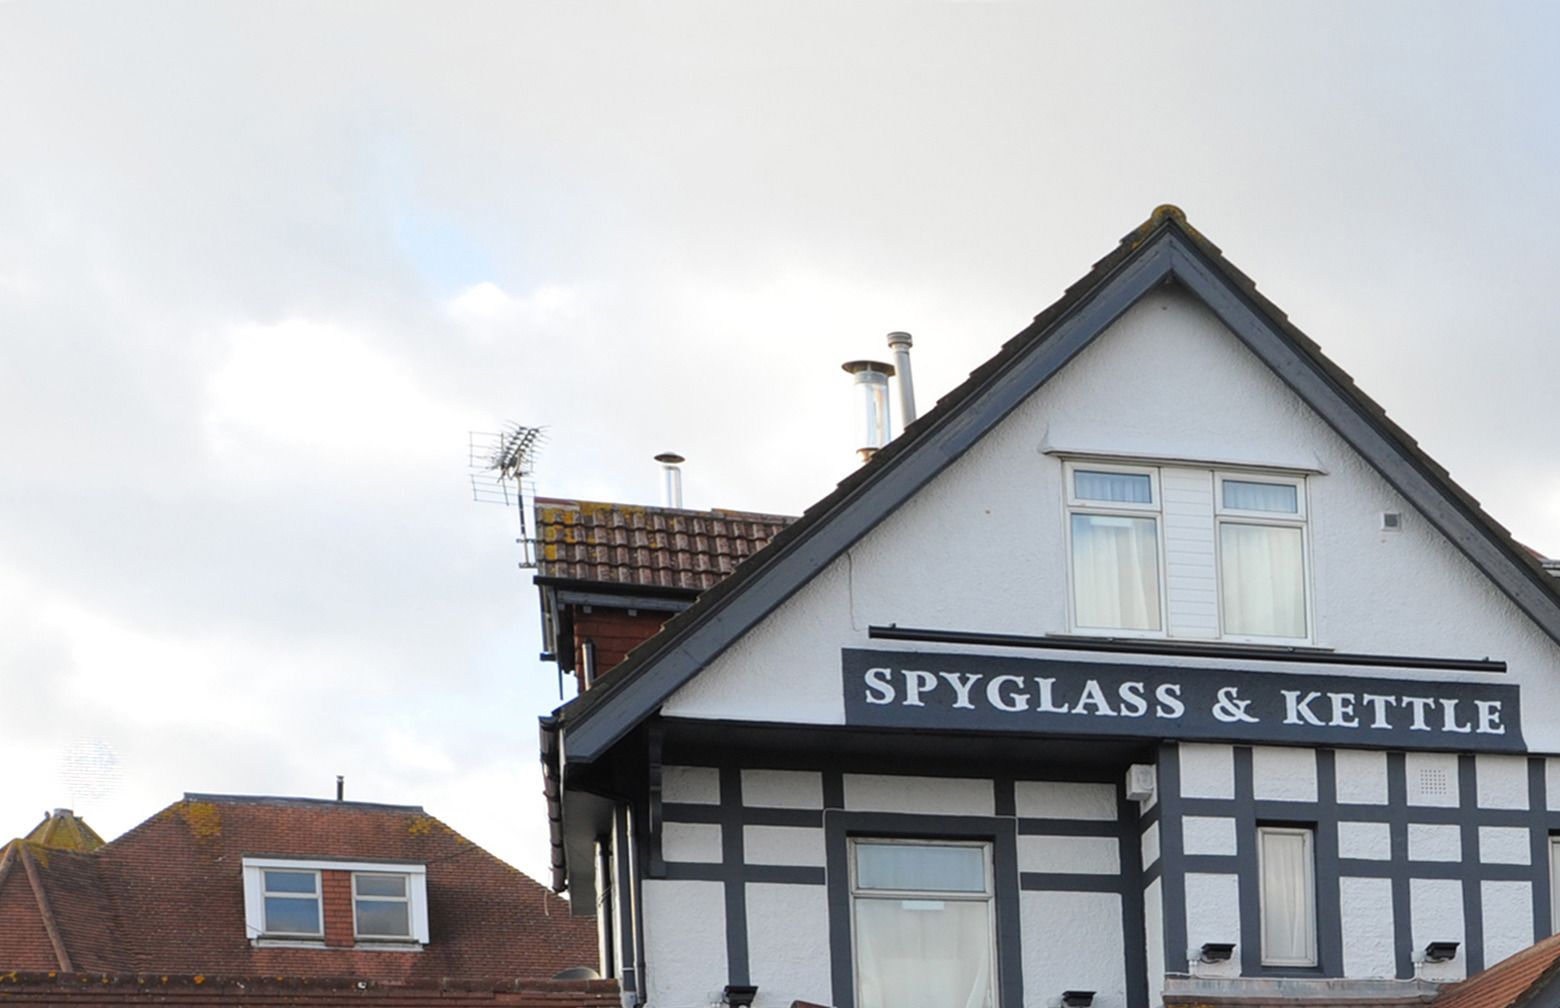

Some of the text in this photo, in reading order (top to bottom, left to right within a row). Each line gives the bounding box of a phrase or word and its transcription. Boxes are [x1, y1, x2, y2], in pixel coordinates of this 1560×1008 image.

[864, 667, 1507, 735] SPYGLASS & KETTLE
